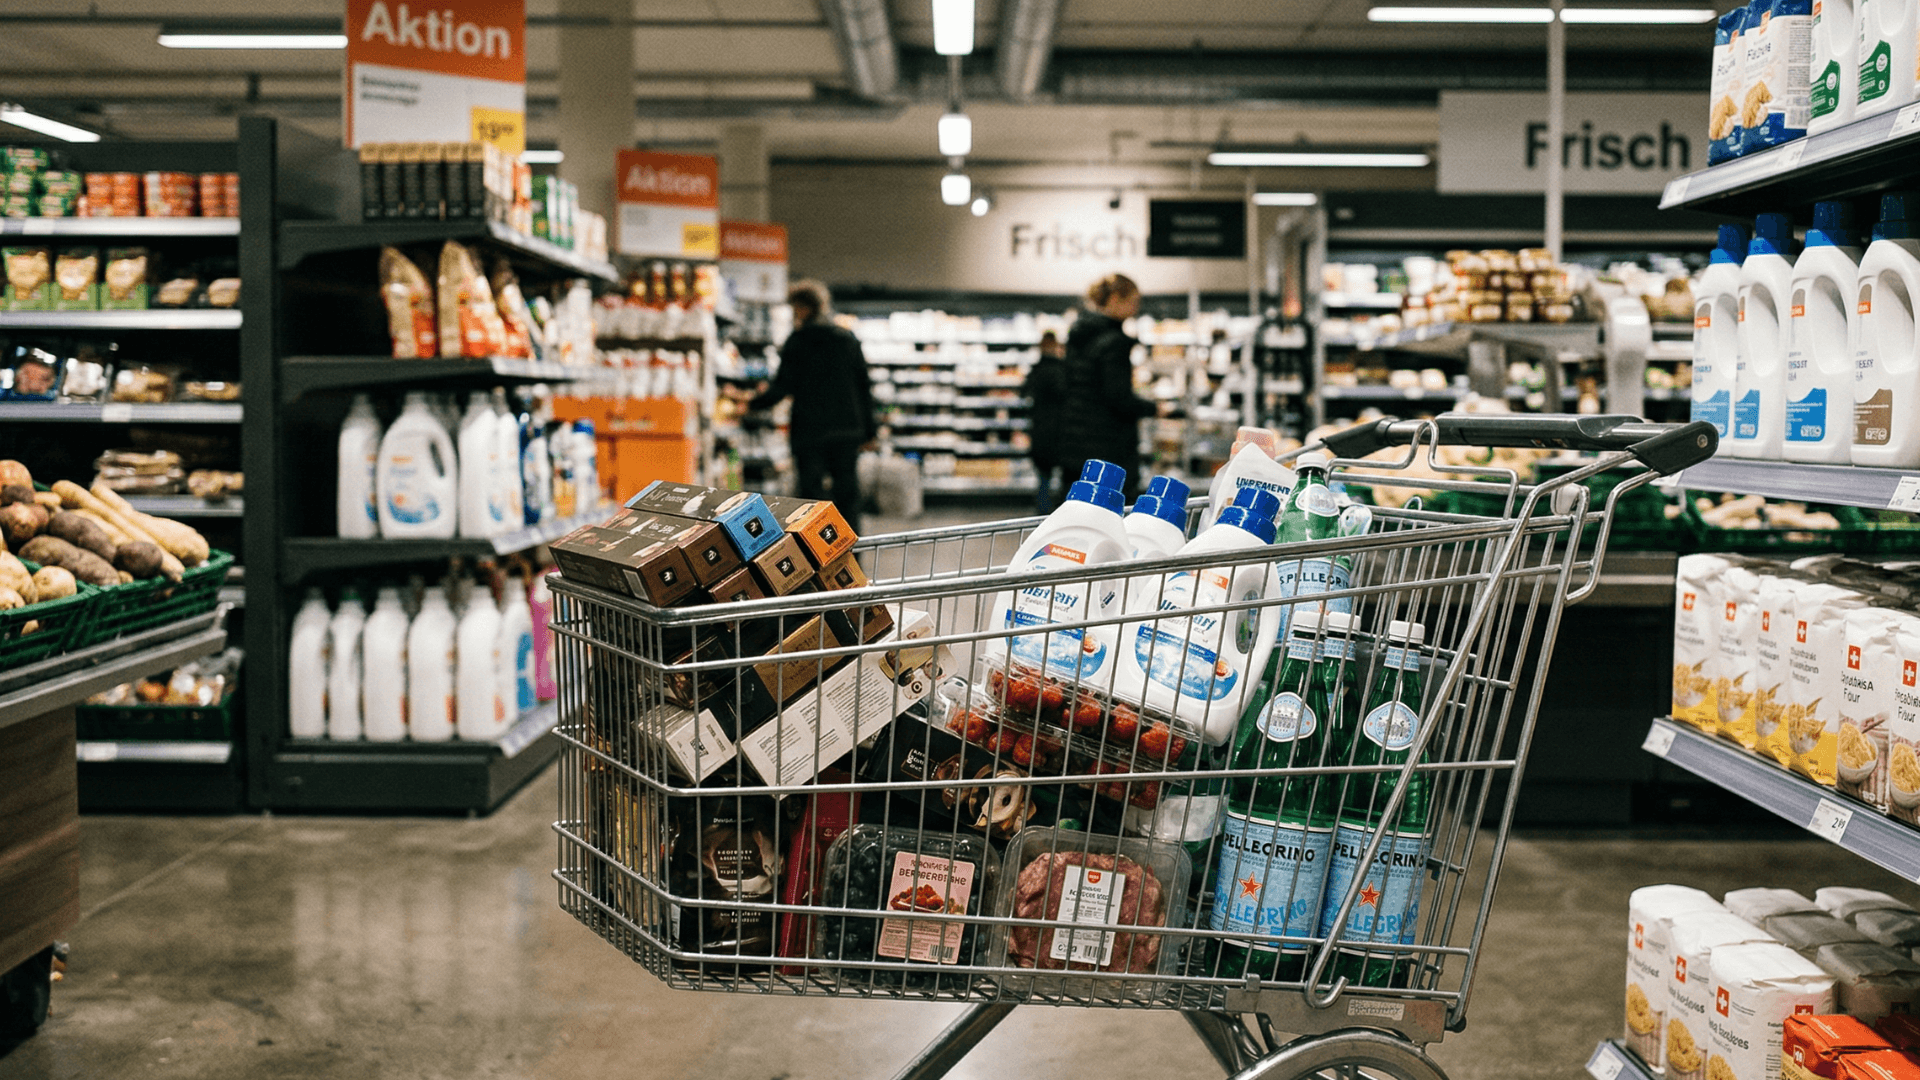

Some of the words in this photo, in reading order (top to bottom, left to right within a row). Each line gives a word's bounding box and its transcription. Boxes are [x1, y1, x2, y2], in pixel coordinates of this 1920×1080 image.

[361, 1, 511, 59] Aktion
[1526, 120, 1691, 169] Frisch
[625, 164, 711, 196] Aktion
[1011, 222, 1137, 257] Frisch
